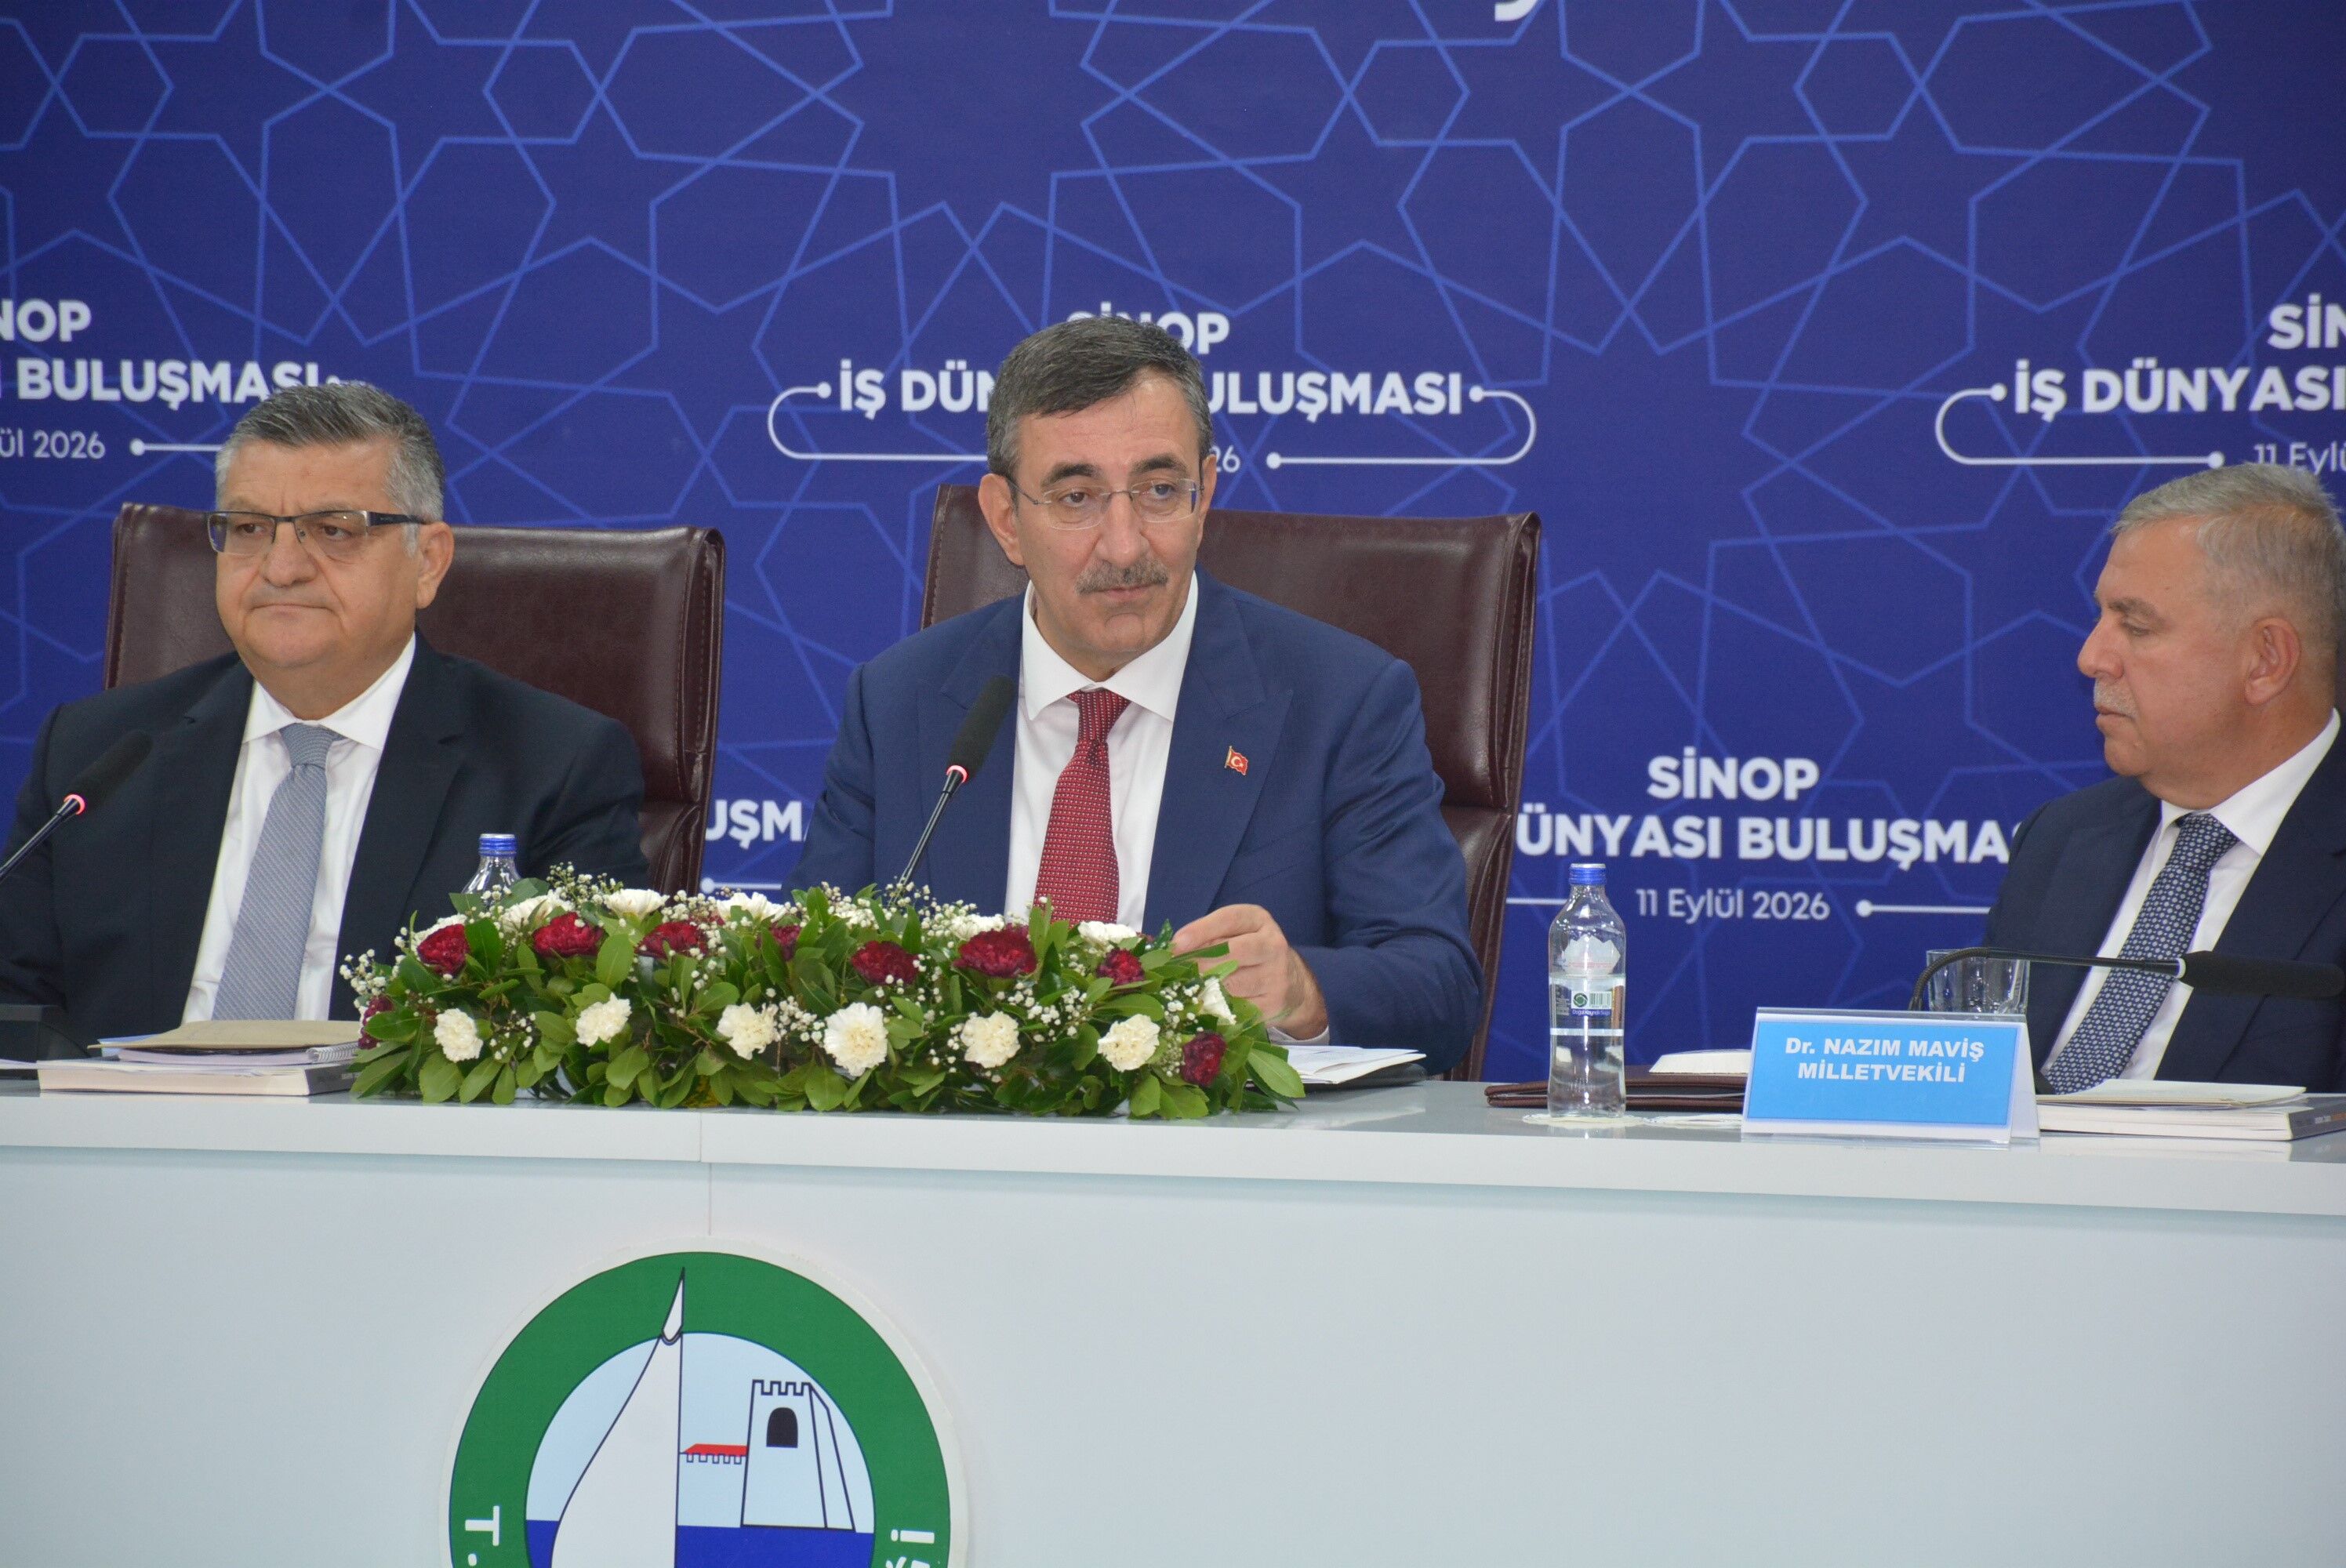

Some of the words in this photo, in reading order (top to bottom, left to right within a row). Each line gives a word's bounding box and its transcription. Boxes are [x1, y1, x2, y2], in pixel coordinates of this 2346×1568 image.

[17, 358, 319, 410] BULUŞMASI
[840, 358, 886, 419] İŞ
[2015, 359, 2067, 423] İŞ
[2083, 358, 2346, 412] DÜNYASI
[33, 430, 106, 459] 2026
[2253, 443, 2277, 465] 11
[1647, 746, 1819, 800] SİNOP
[1516, 802, 1722, 858] ÜNYASI
[1738, 817, 2022, 871] BULUŞMA
[1636, 888, 1658, 916] 11
[1668, 887, 1744, 924] Eylül
[1752, 891, 1830, 920] 2026
[1785, 1037, 1815, 1054] Dr.
[1824, 1038, 1901, 1056] NAZIM
[1908, 1037, 1985, 1062] MAVİŞ
[1798, 1058, 1966, 1083] MİLLETVEKİLİ
